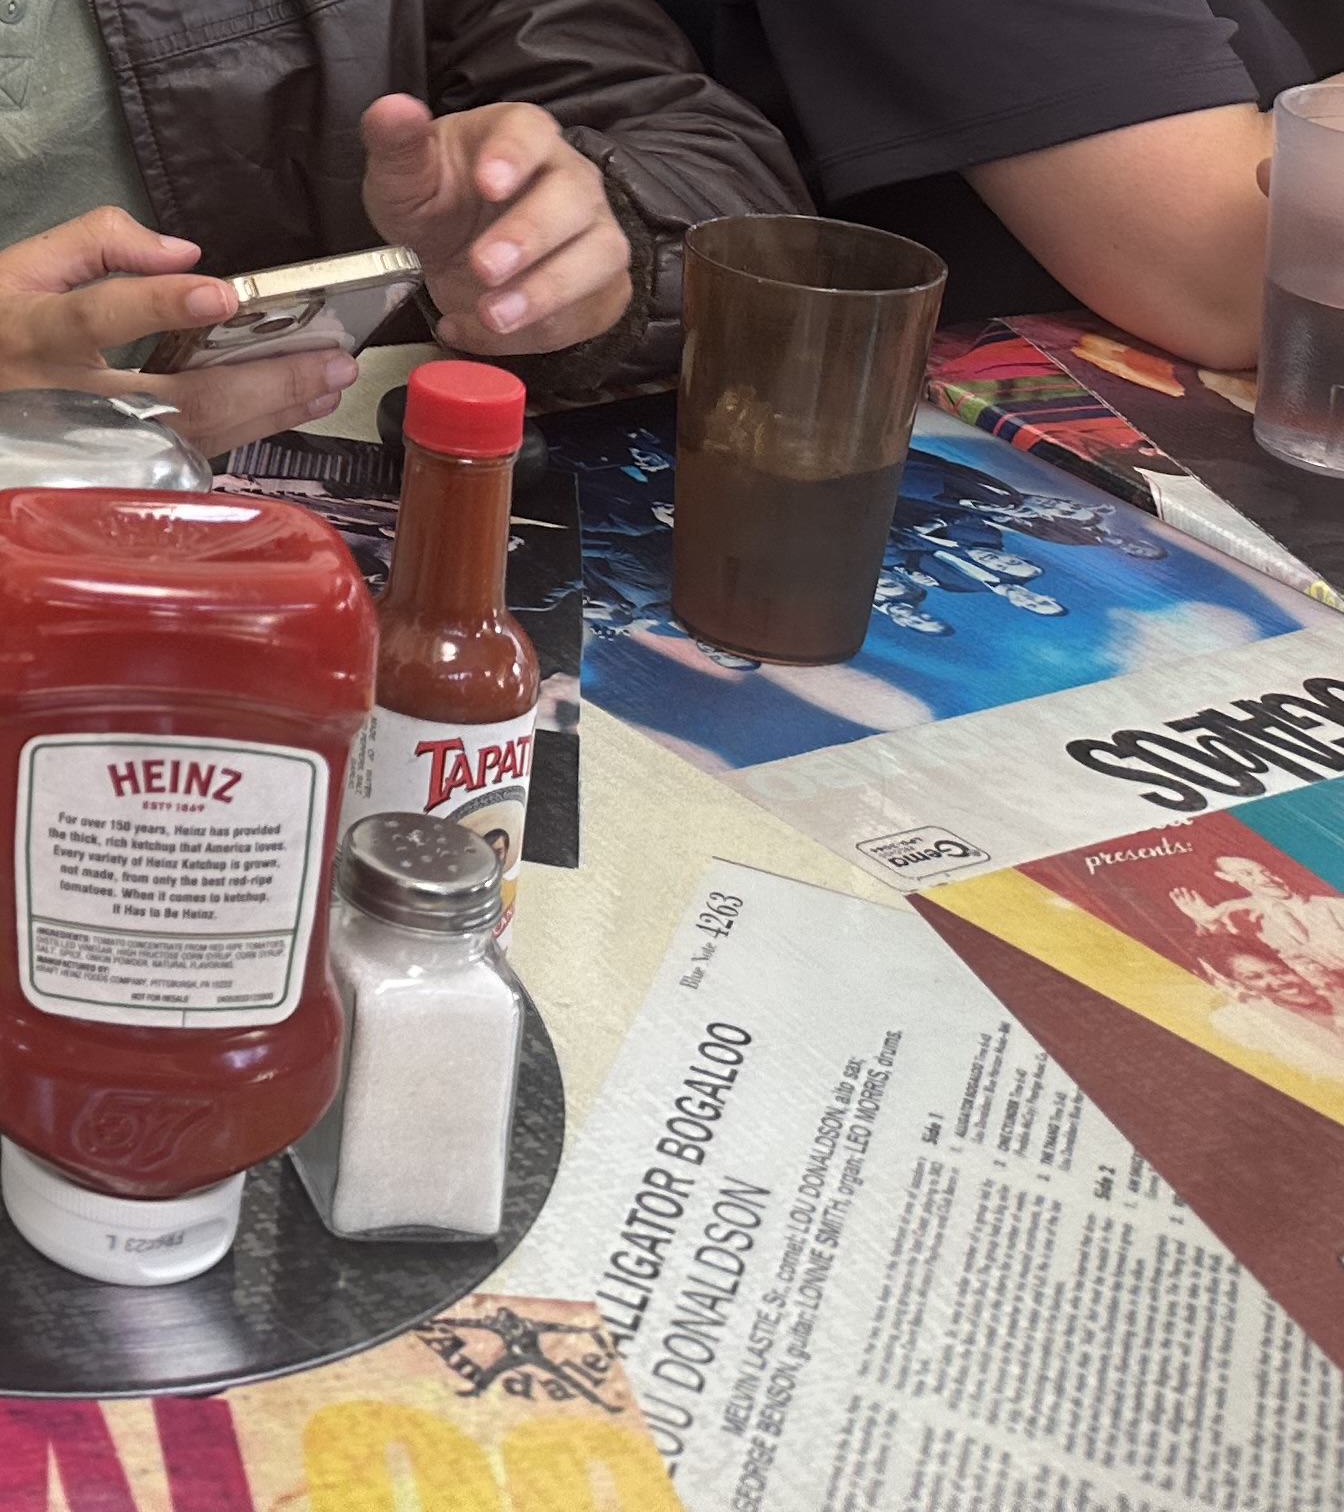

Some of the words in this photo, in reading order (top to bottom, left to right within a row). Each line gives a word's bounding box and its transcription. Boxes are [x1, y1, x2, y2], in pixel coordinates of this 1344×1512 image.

[107, 759, 243, 804] HEINZ
[176, 802, 206, 813] 1869
[887, 834, 971, 868] Gema
[1084, 837, 1194, 876] presents:
[695, 891, 744, 938] 4263
[690, 942, 717, 962] Note
[678, 966, 705, 990] Blue
[655, 1022, 753, 1166] BOGALOO
[921, 1122, 942, 1146] Side
[1094, 1176, 1114, 1201] Side
[651, 1175, 772, 1395] DONALDSON
